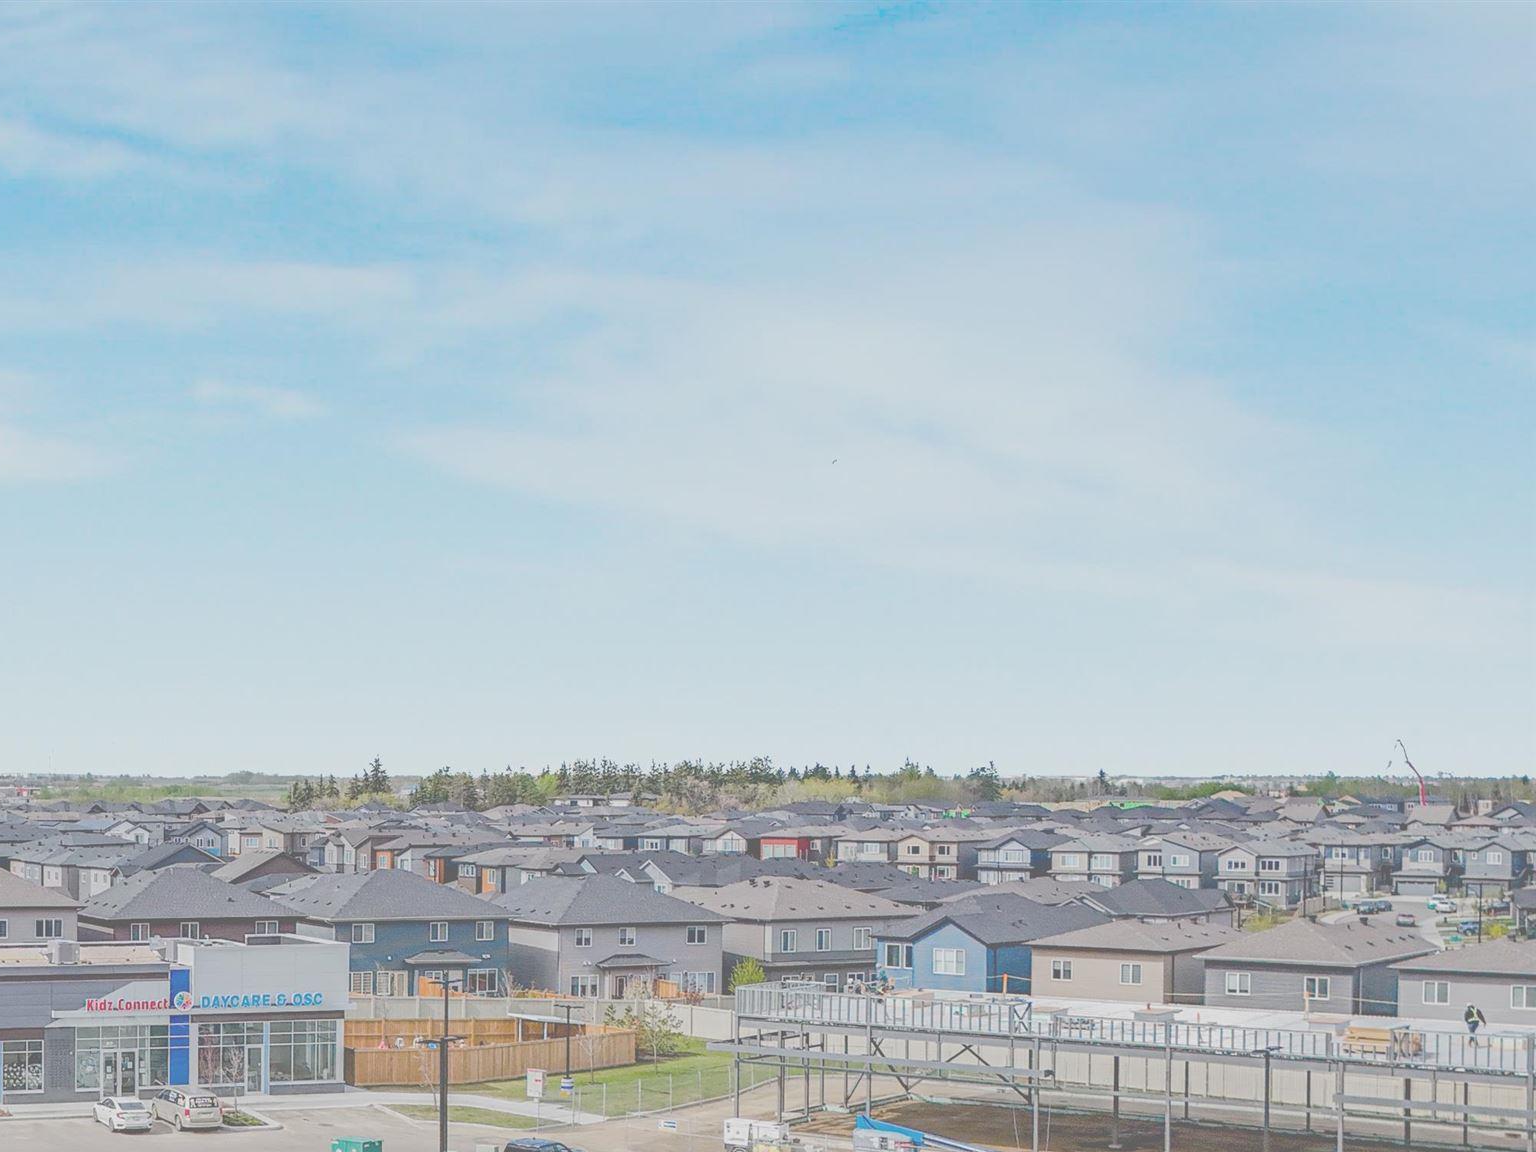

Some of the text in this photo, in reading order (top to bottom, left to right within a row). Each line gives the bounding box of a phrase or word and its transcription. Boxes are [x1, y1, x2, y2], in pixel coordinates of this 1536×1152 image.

[86, 992, 323, 1012] Kidz Connect DAYCARE & OSC
